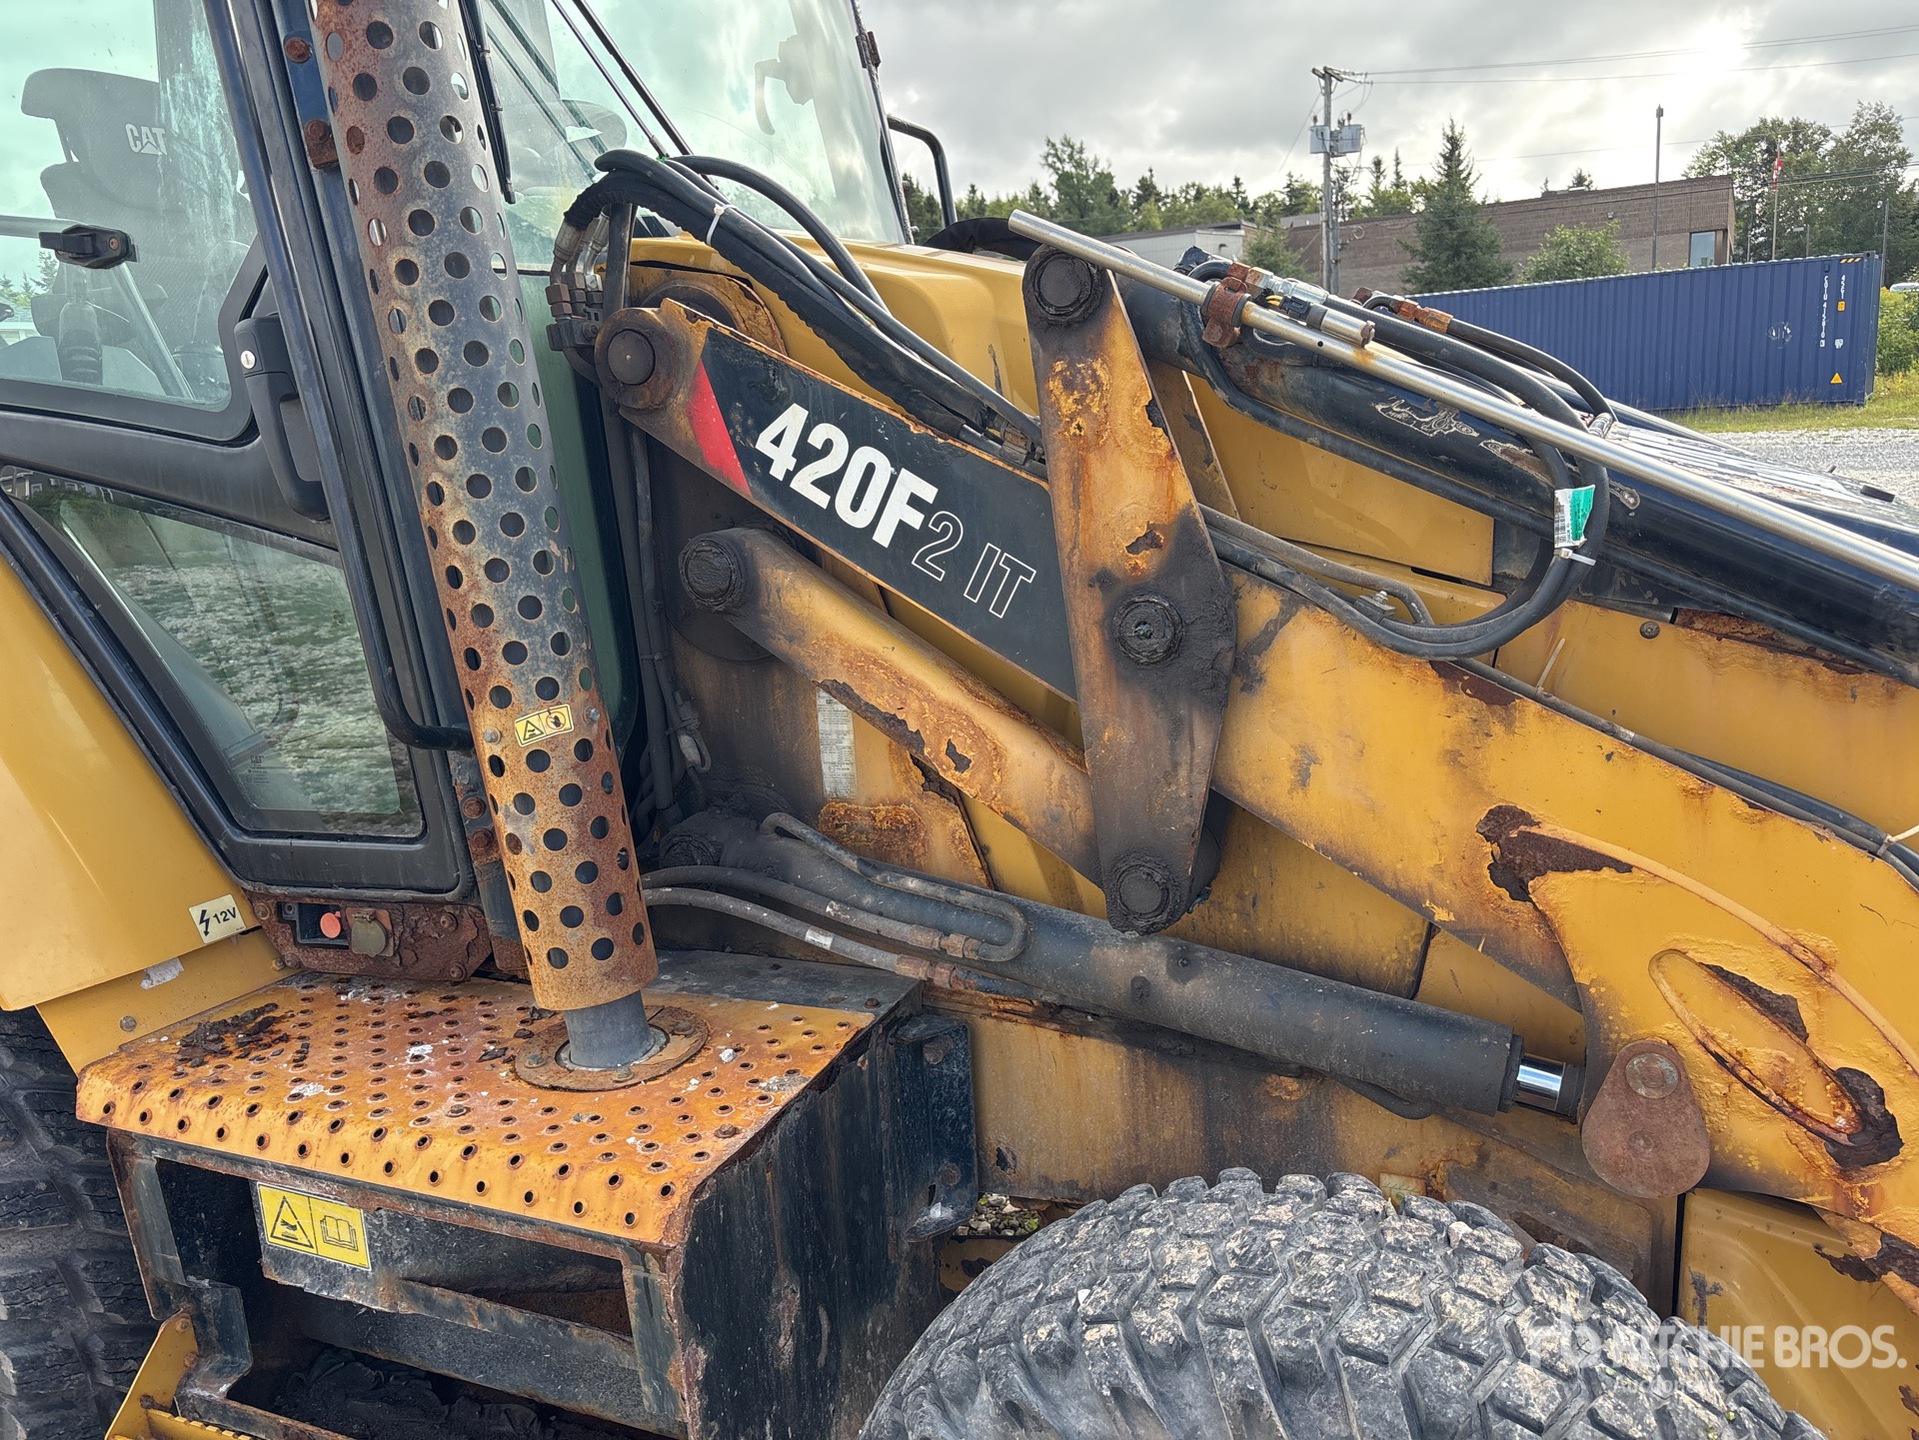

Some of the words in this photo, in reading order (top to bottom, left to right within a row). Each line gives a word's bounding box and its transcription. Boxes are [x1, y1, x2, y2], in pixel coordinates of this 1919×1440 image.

[125, 123, 168, 156] CAT
[963, 542, 1037, 619] IT
[212, 906, 237, 924] 12V
